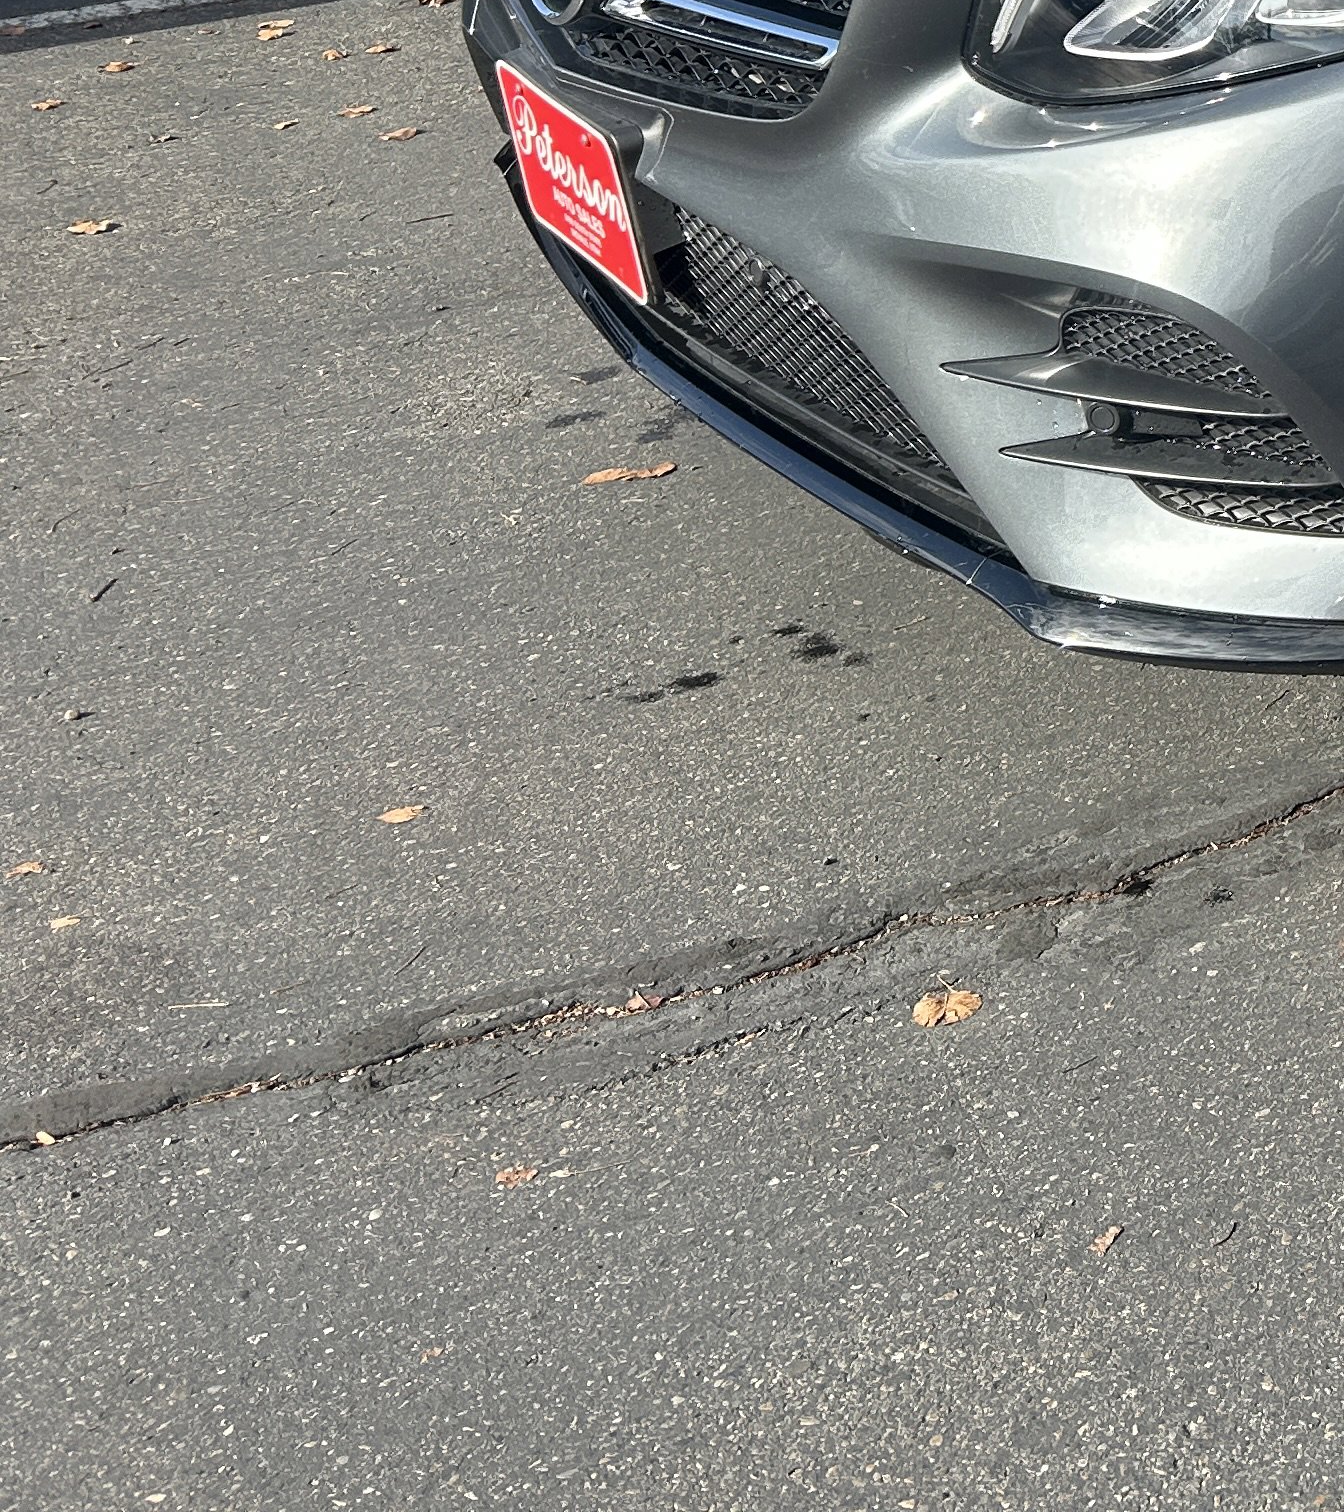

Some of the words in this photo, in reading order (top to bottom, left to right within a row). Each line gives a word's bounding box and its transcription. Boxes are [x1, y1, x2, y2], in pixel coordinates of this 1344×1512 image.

[512, 95, 627, 232] Peterson
[553, 185, 576, 216] AUTO
[575, 203, 607, 239] SALES
